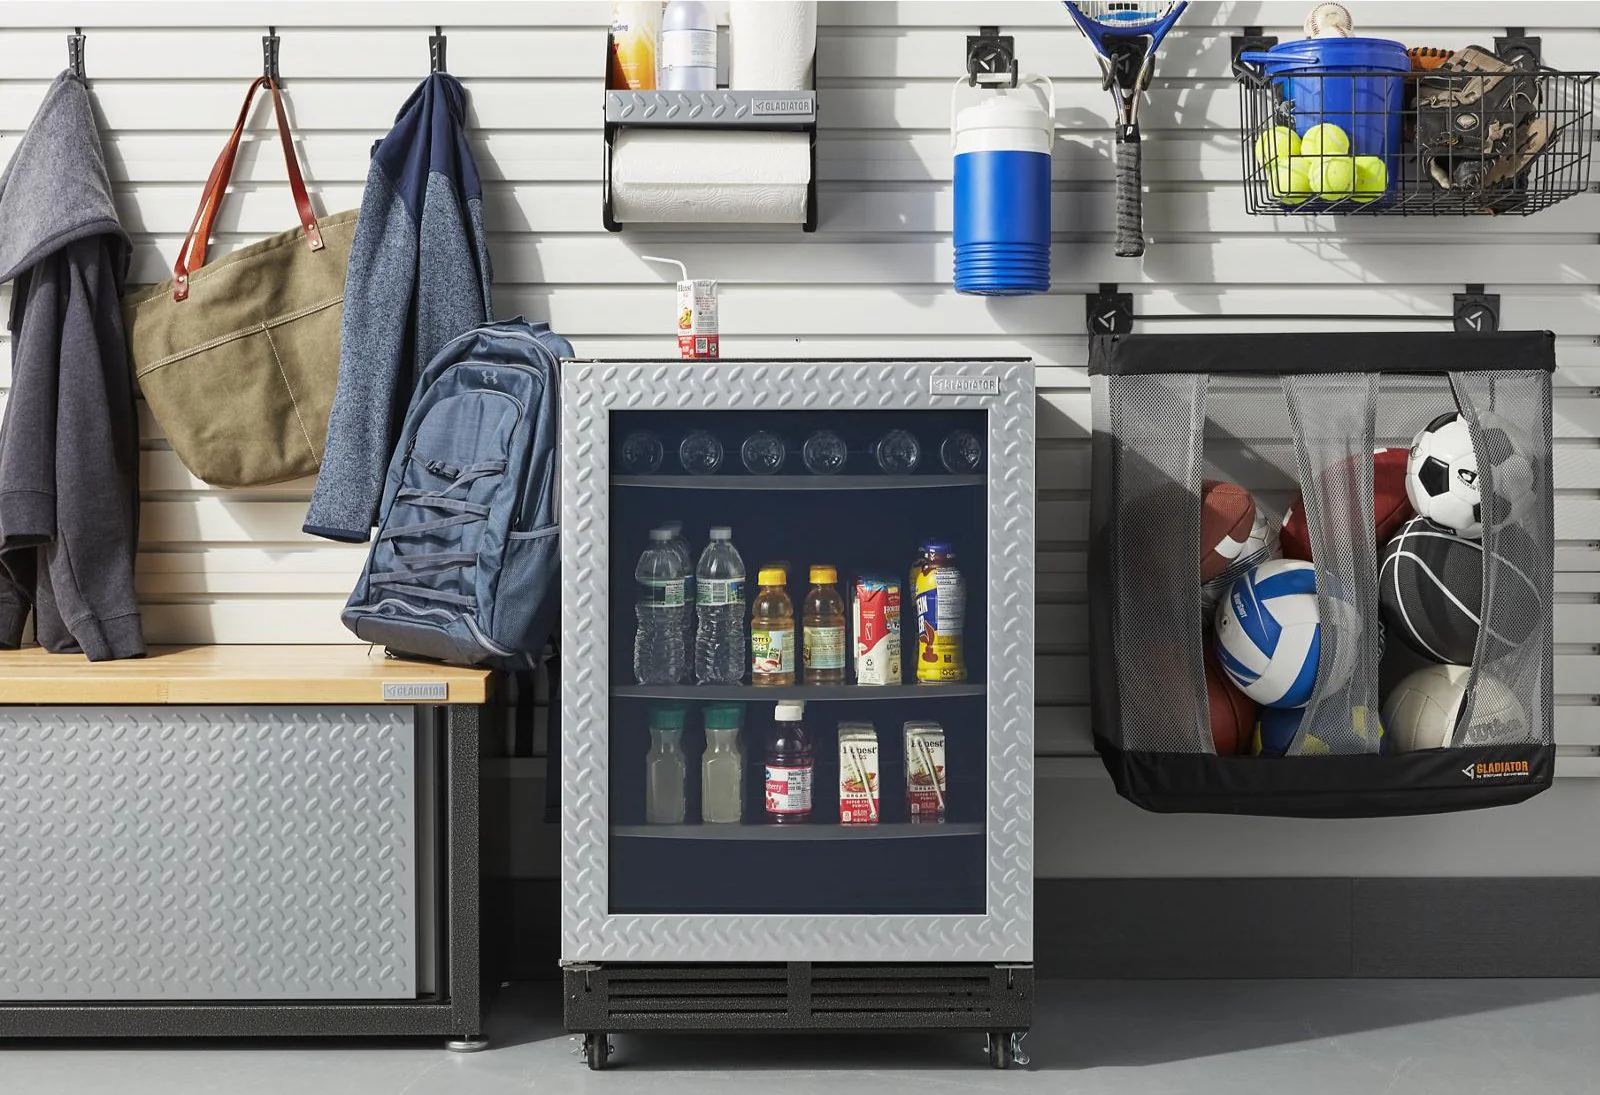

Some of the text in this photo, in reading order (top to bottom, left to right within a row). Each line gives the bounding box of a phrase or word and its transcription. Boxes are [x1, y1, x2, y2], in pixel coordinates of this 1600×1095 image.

[765, 101, 809, 111] GLADIATOR
[944, 379, 996, 391] GLADIATOR
[397, 686, 446, 697] GLADIATOR
[1476, 761, 1529, 774] GLADIATOR
